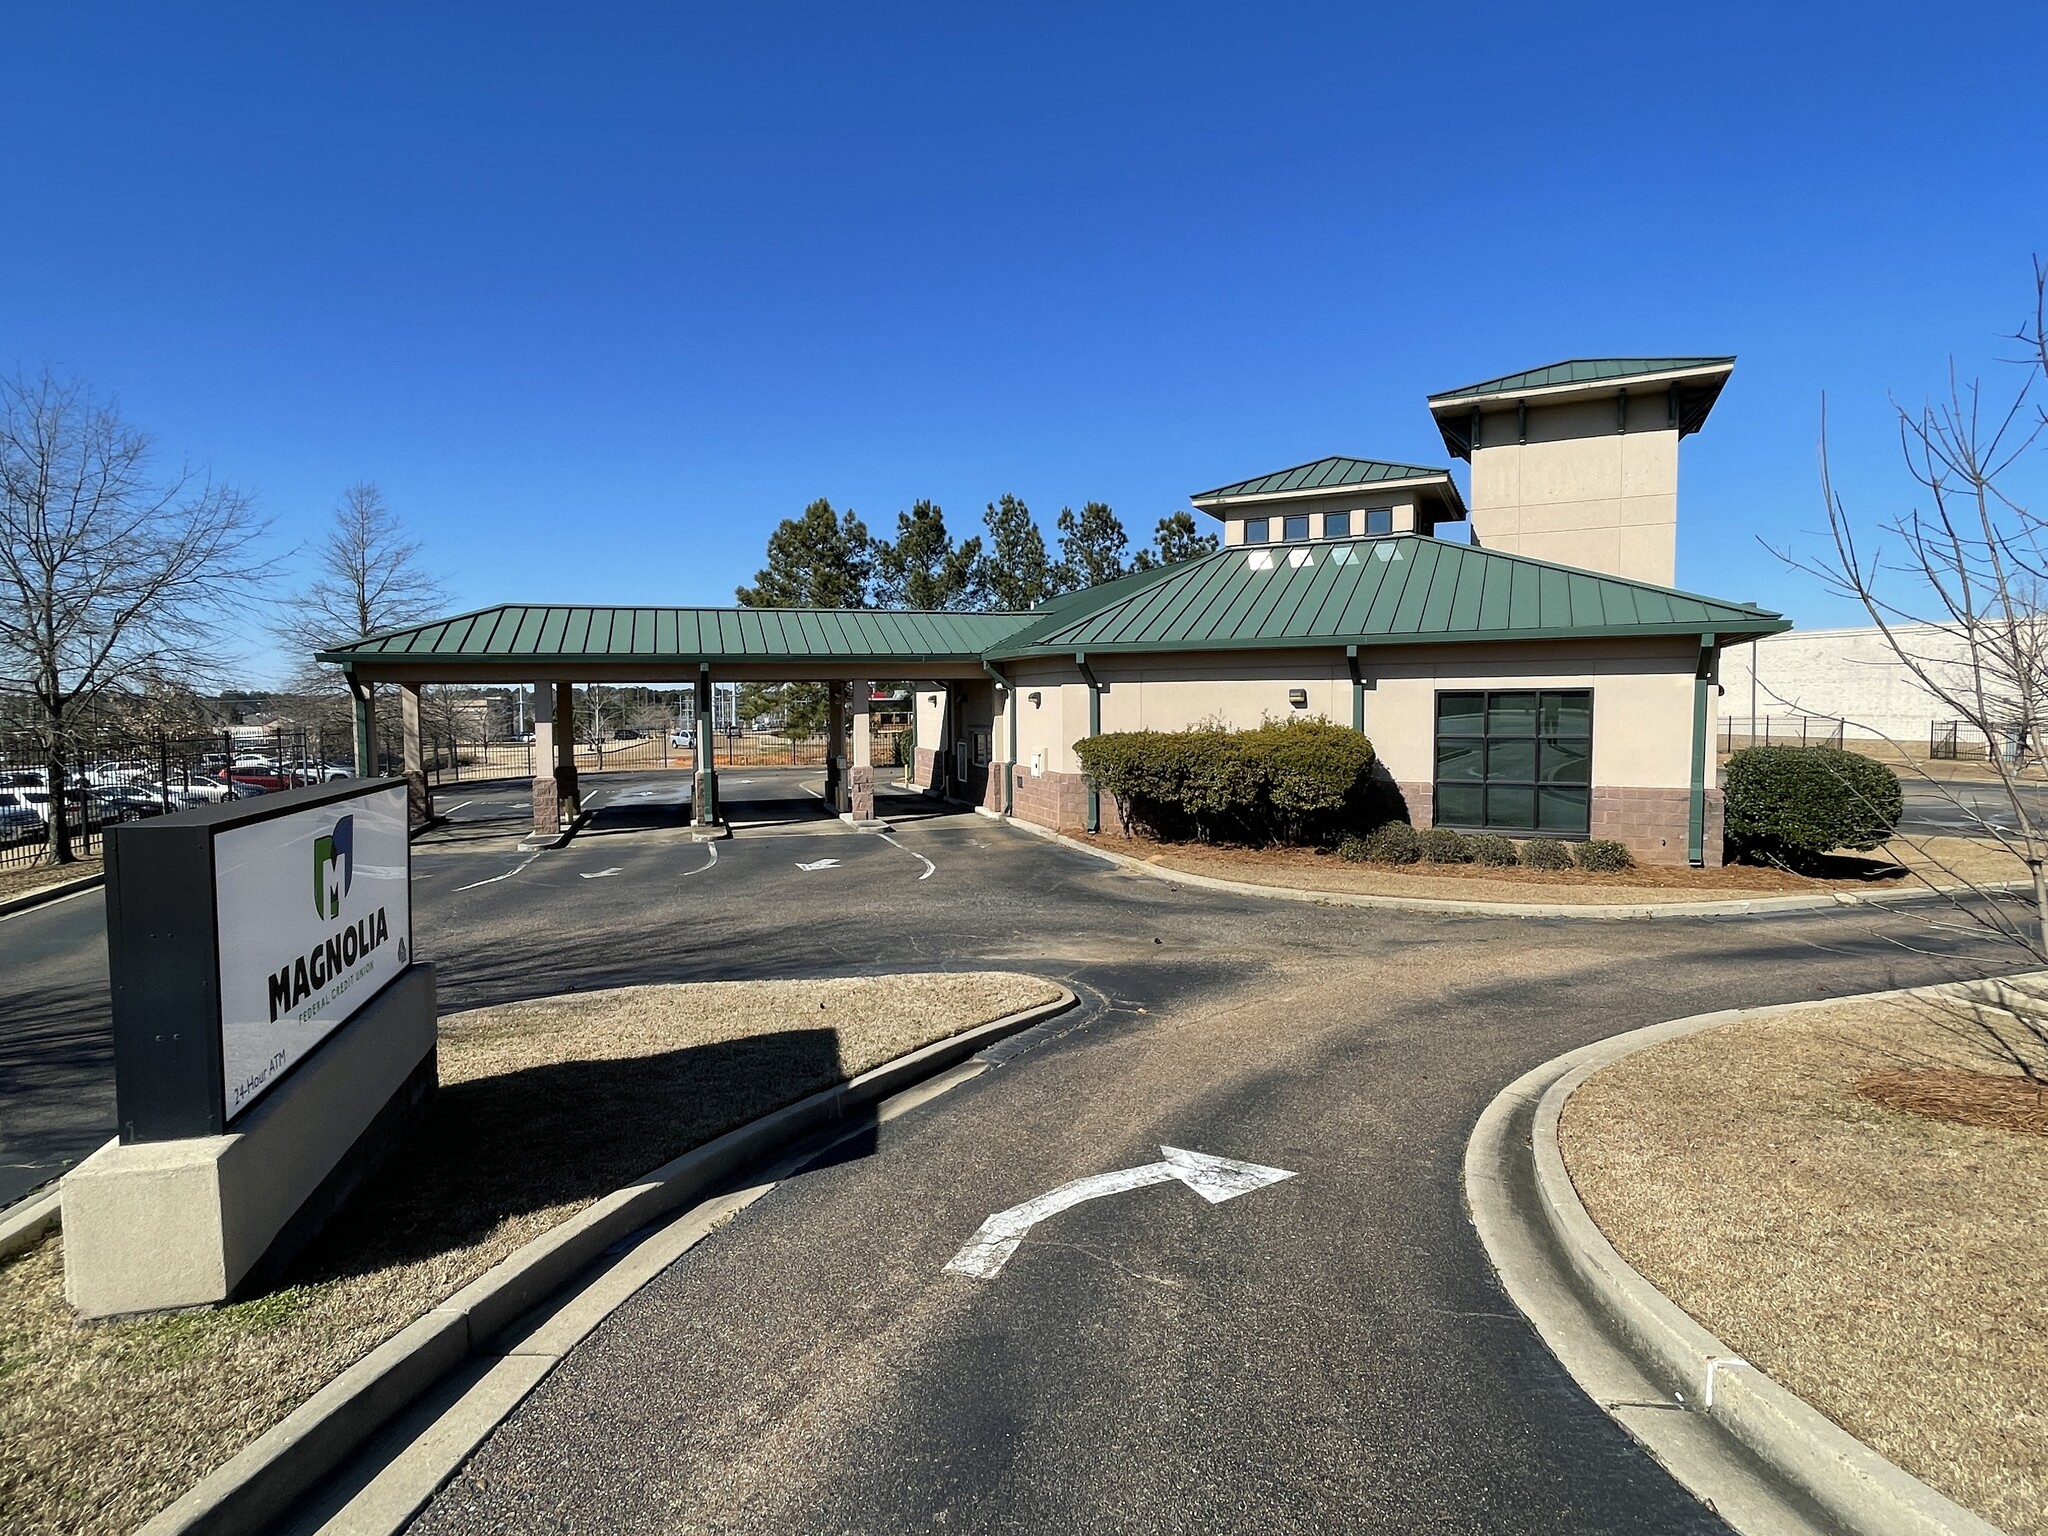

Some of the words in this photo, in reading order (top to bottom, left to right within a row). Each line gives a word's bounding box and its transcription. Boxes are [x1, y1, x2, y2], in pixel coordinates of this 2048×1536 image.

[268, 906, 389, 1024] MAGNOLIA
[298, 995, 330, 1026] FEDERAL
[331, 975, 354, 1000] CREDIT
[355, 961, 374, 982] UNION
[234, 1069, 267, 1106] 24-Hour
[269, 1048, 286, 1075] ATM
